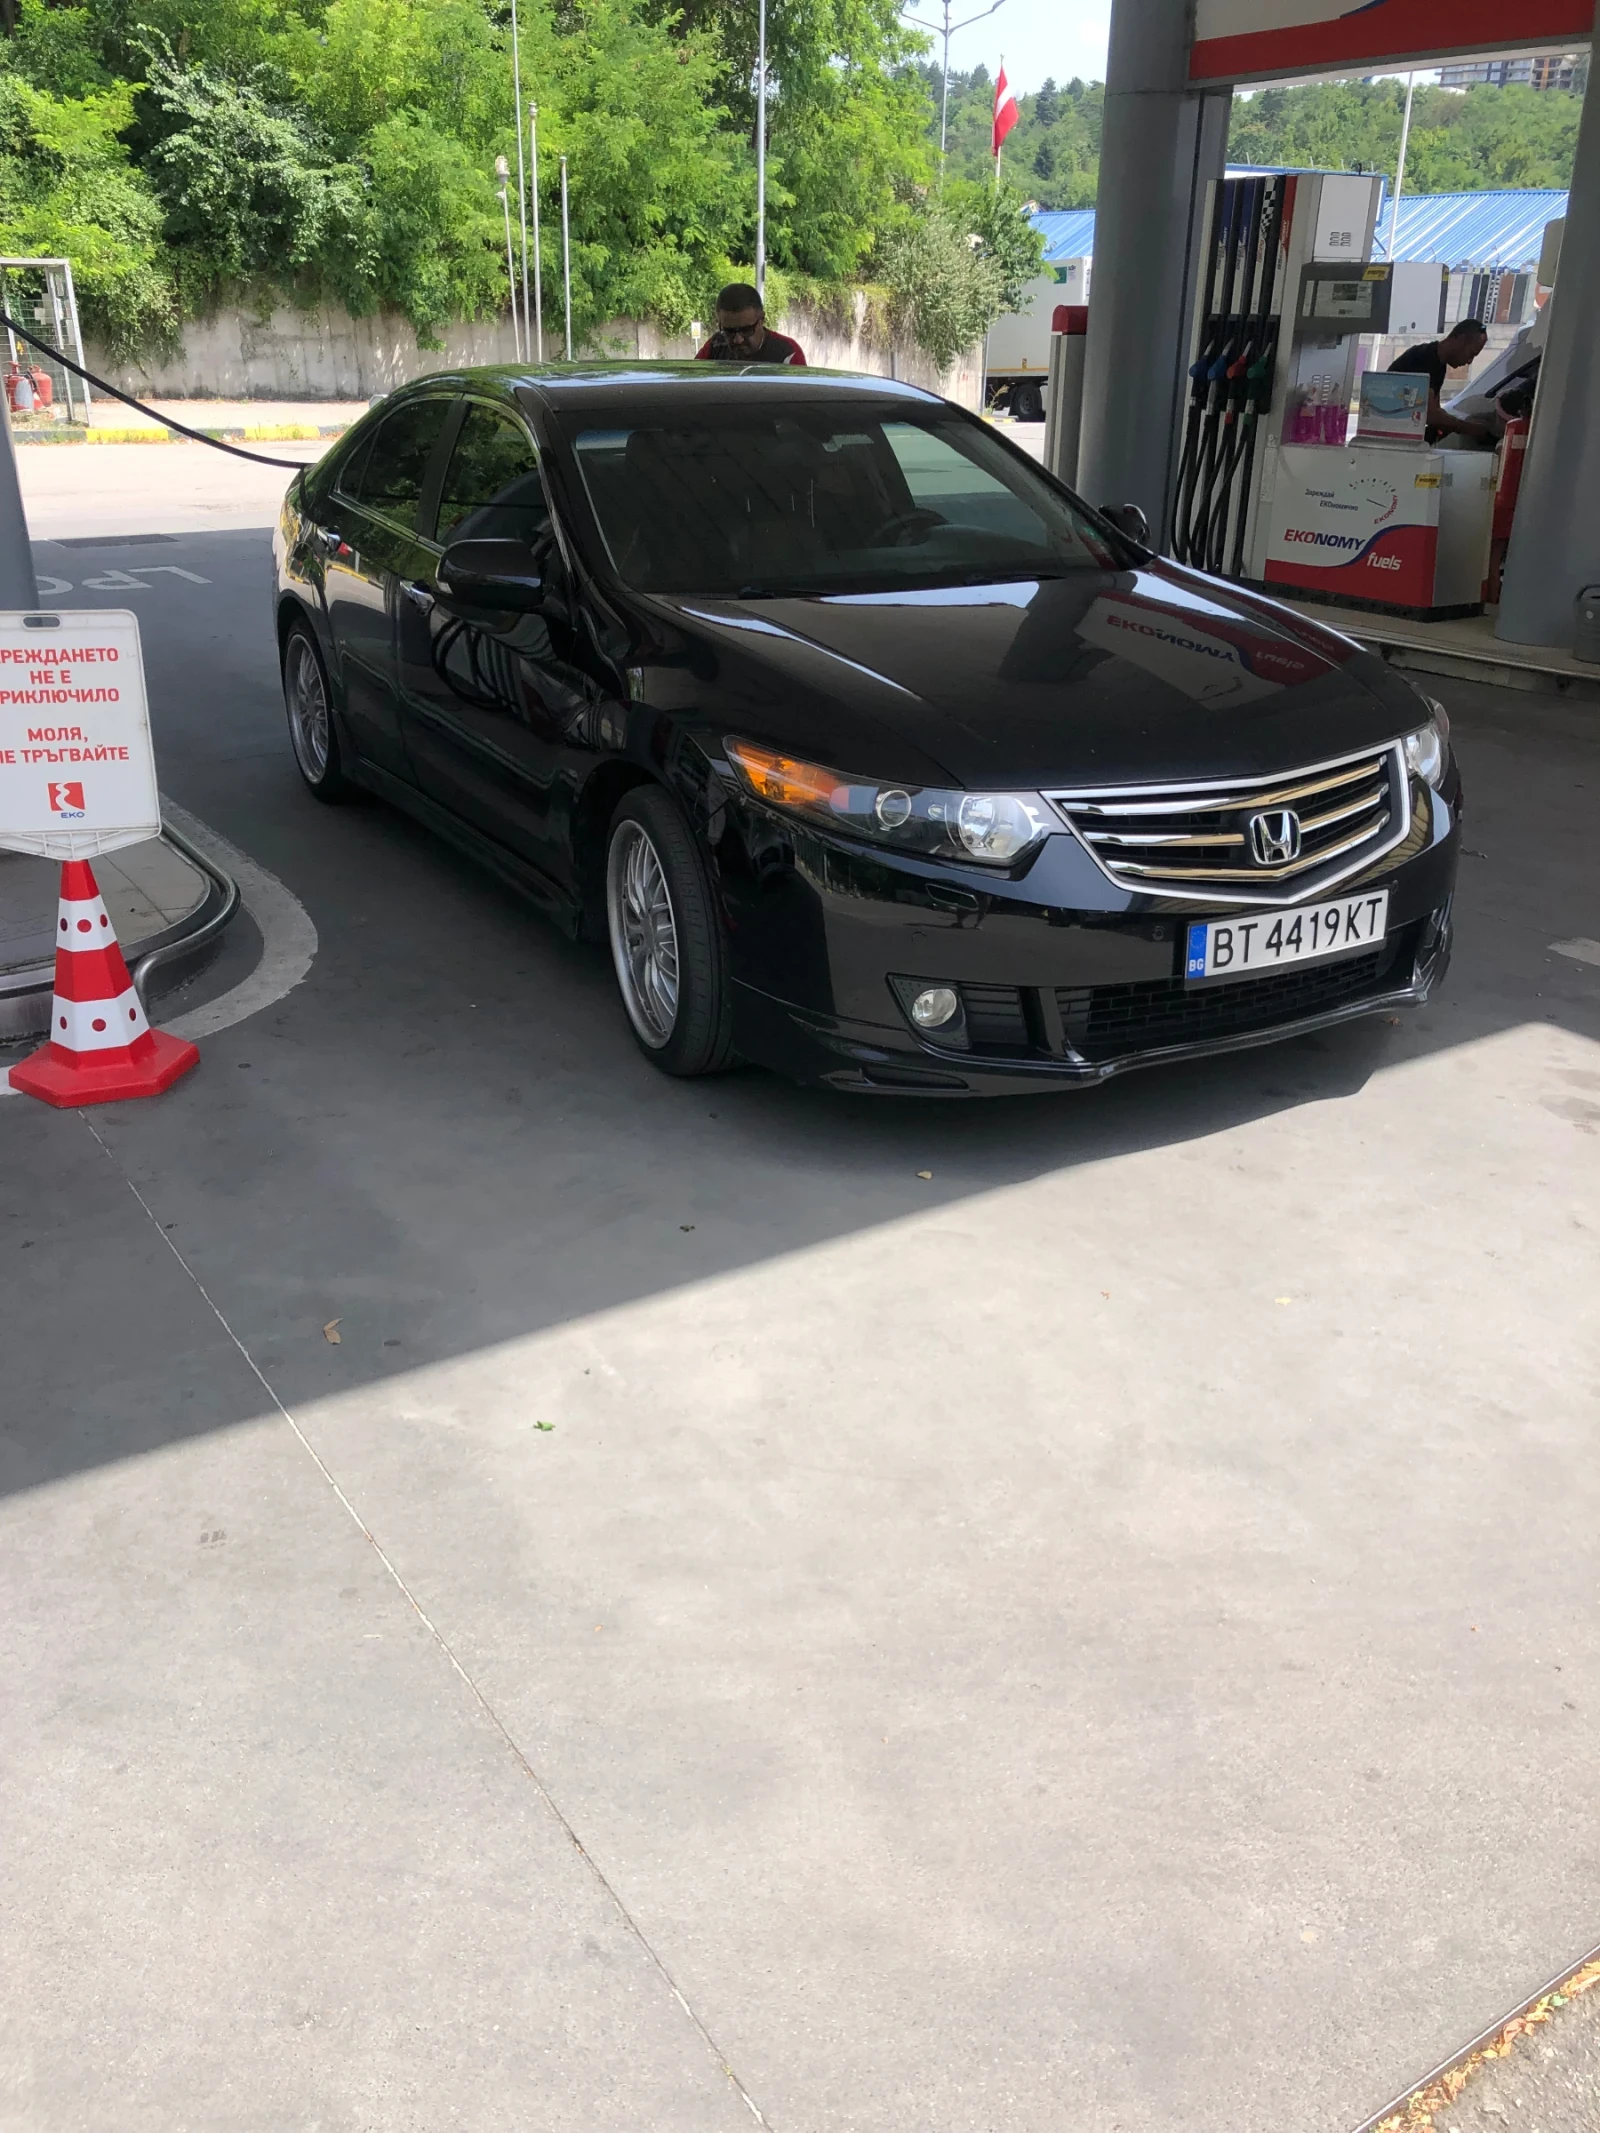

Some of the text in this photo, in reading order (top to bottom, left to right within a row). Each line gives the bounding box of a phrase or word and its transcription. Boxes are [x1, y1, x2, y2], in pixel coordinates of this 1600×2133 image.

[1374, 495, 1398, 524] EKONOMY
[1284, 529, 1366, 550] EKONOMY
[1367, 552, 1402, 571] fuels
[0, 648, 119, 665] РЕЖДАНЕТО
[30, 670, 72, 684] НЕ Е
[27, 727, 88, 743] МОЛЯ,
[20, 744, 129, 763] ТРЪГВАЙТЕ
[1188, 958, 1204, 972] BG
[1212, 922, 1259, 969] BT
